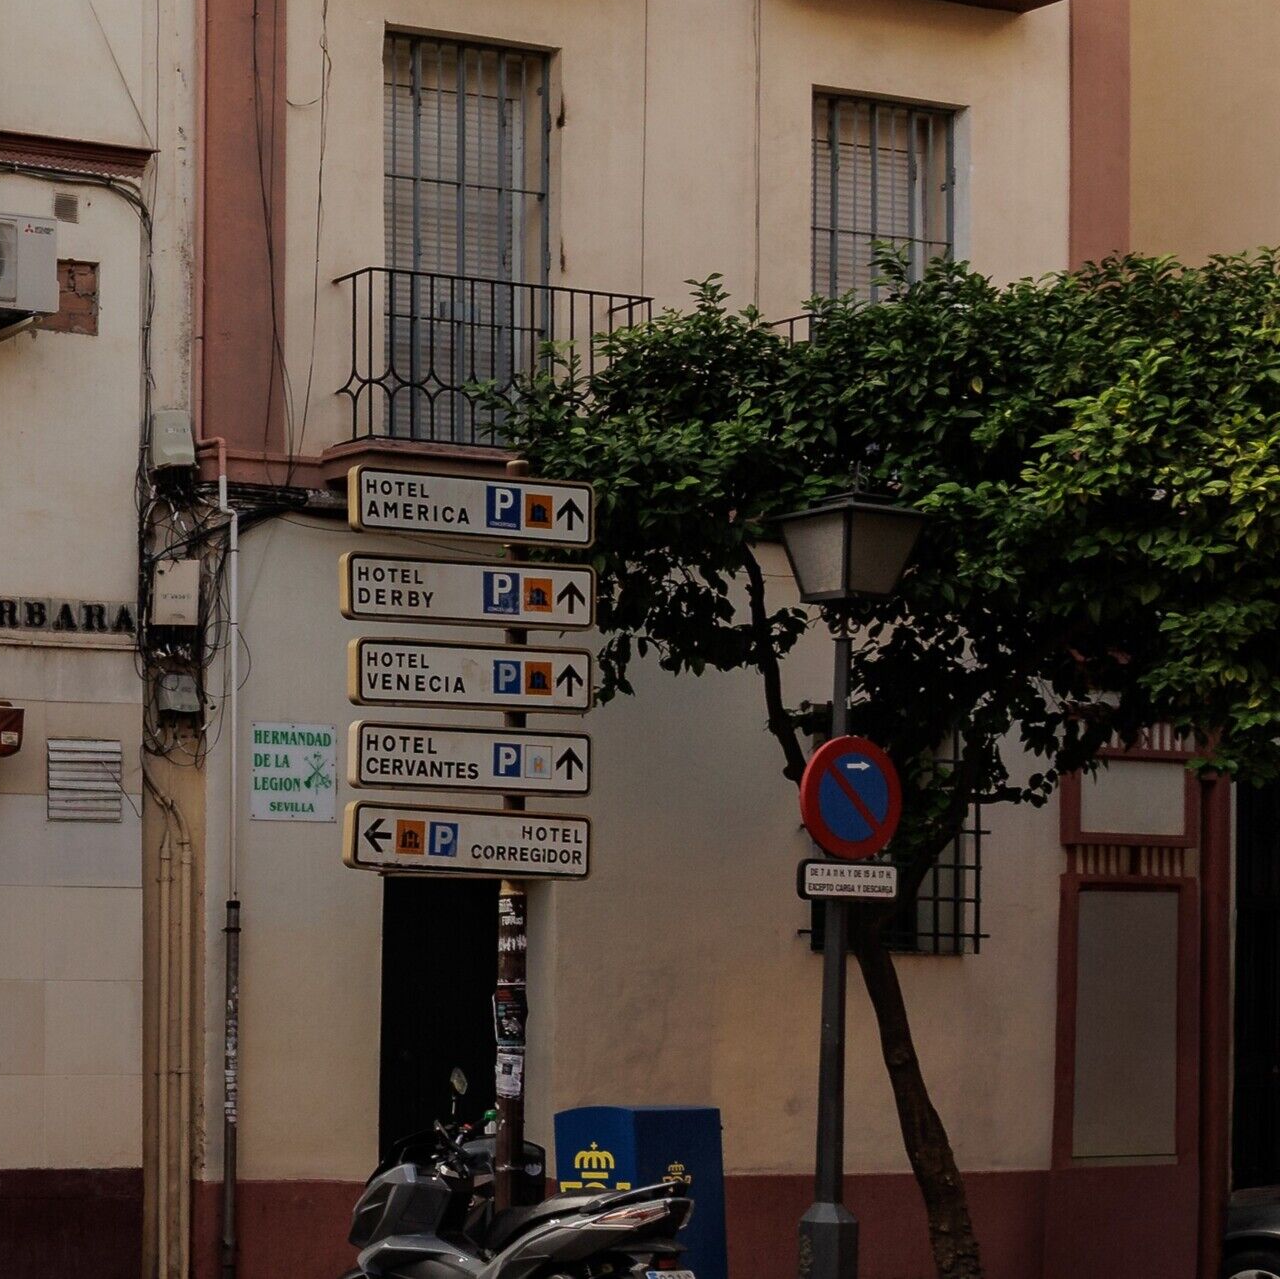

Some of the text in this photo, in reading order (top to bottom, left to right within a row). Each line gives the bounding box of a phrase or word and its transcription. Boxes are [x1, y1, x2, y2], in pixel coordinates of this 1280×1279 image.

[366, 479, 430, 499] HOTEL
[366, 500, 470, 525] AMERICA
[495, 488, 514, 520] P
[357, 566, 424, 585] HOTEL
[358, 587, 434, 608] DERBY
[493, 573, 513, 606] P
[366, 651, 430, 670] HOTEL
[366, 672, 466, 694] VENECIA
[499, 663, 517, 692] P
[253, 729, 332, 747] HERMANDAD
[366, 734, 438, 755] HOTEL
[253, 753, 291, 769] DE LA
[365, 757, 480, 781] CERVANTES
[499, 746, 517, 774] P
[253, 776, 302, 792] LEGION
[269, 801, 315, 813] SEVILLA
[434, 825, 454, 853] P
[521, 825, 583, 844] HOTEL
[471, 844, 583, 865] CORREGIDOR
[810, 868, 819, 876] DE
[826, 869, 831, 877] A
[847, 869, 852, 877] Y
[854, 870, 862, 878] DE
[872, 870, 877, 878] A
[808, 883, 834, 892] EXCEPTO
[835, 884, 855, 893] CARGA
[862, 884, 893, 894] DESCARGA
